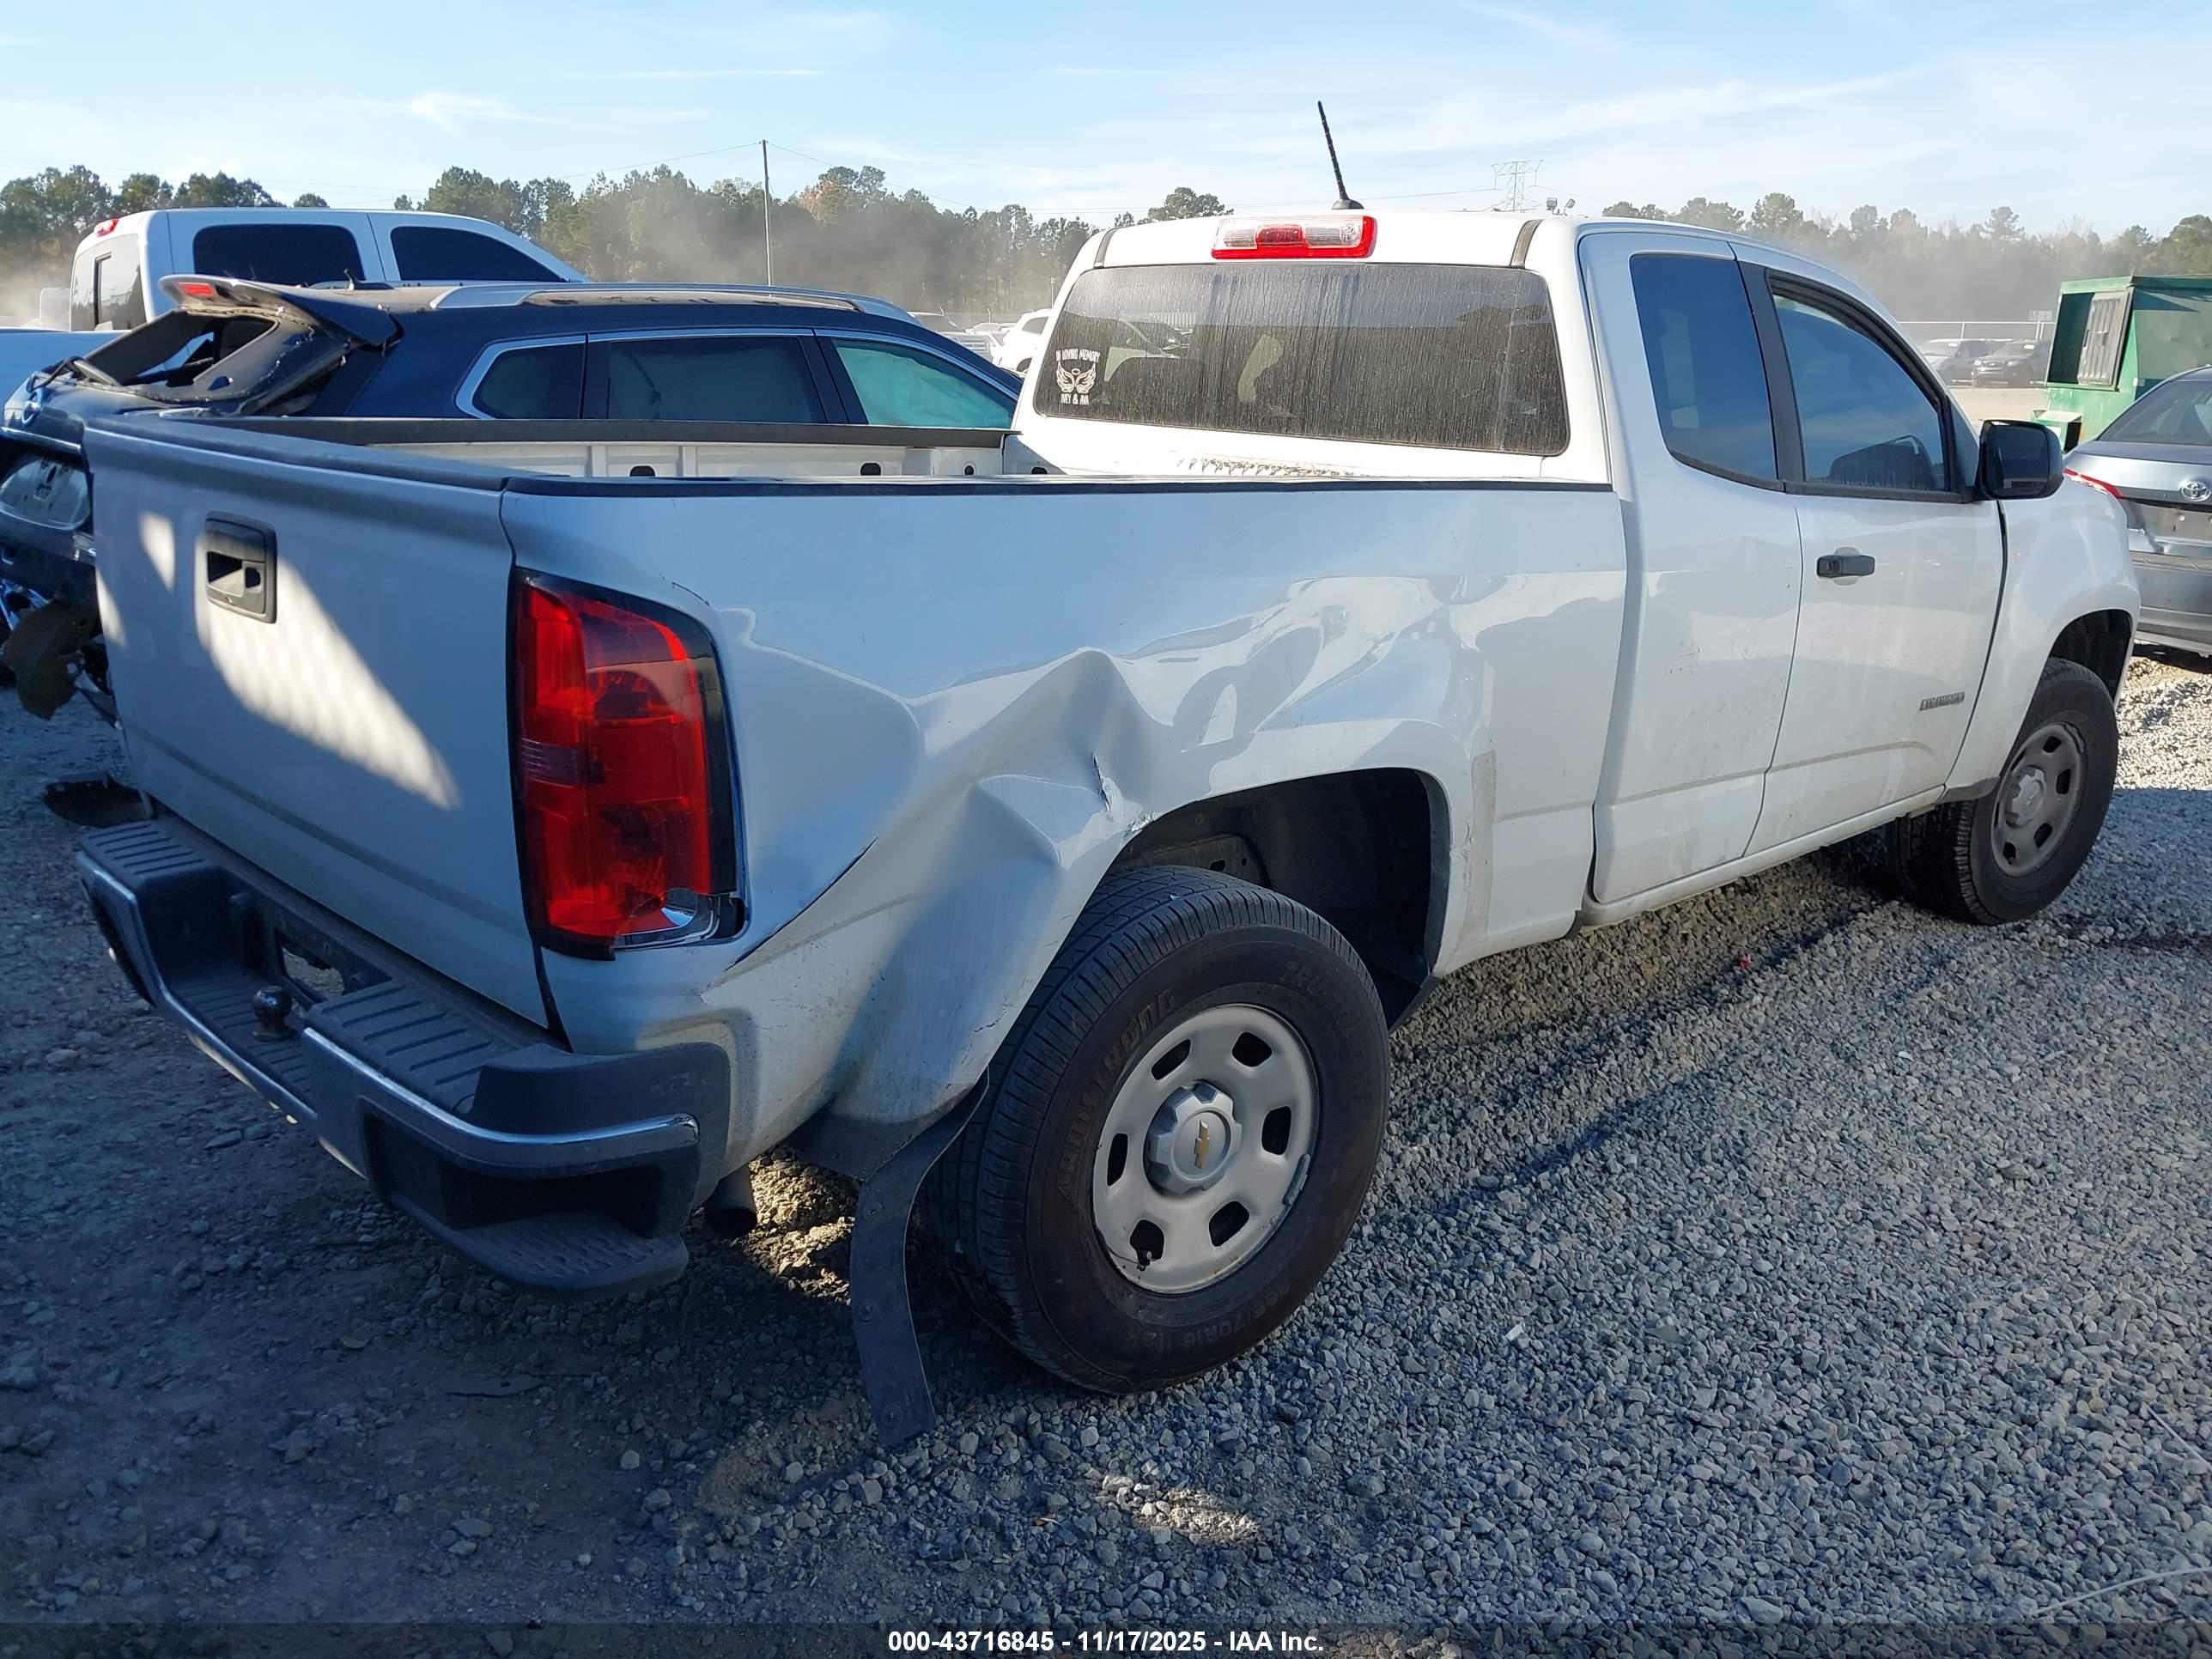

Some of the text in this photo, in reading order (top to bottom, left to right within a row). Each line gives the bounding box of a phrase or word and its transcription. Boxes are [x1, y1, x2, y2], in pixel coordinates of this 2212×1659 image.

[1055, 348, 1101, 363] IN LOVING MEMORY
[1073, 393, 1079, 404] &
